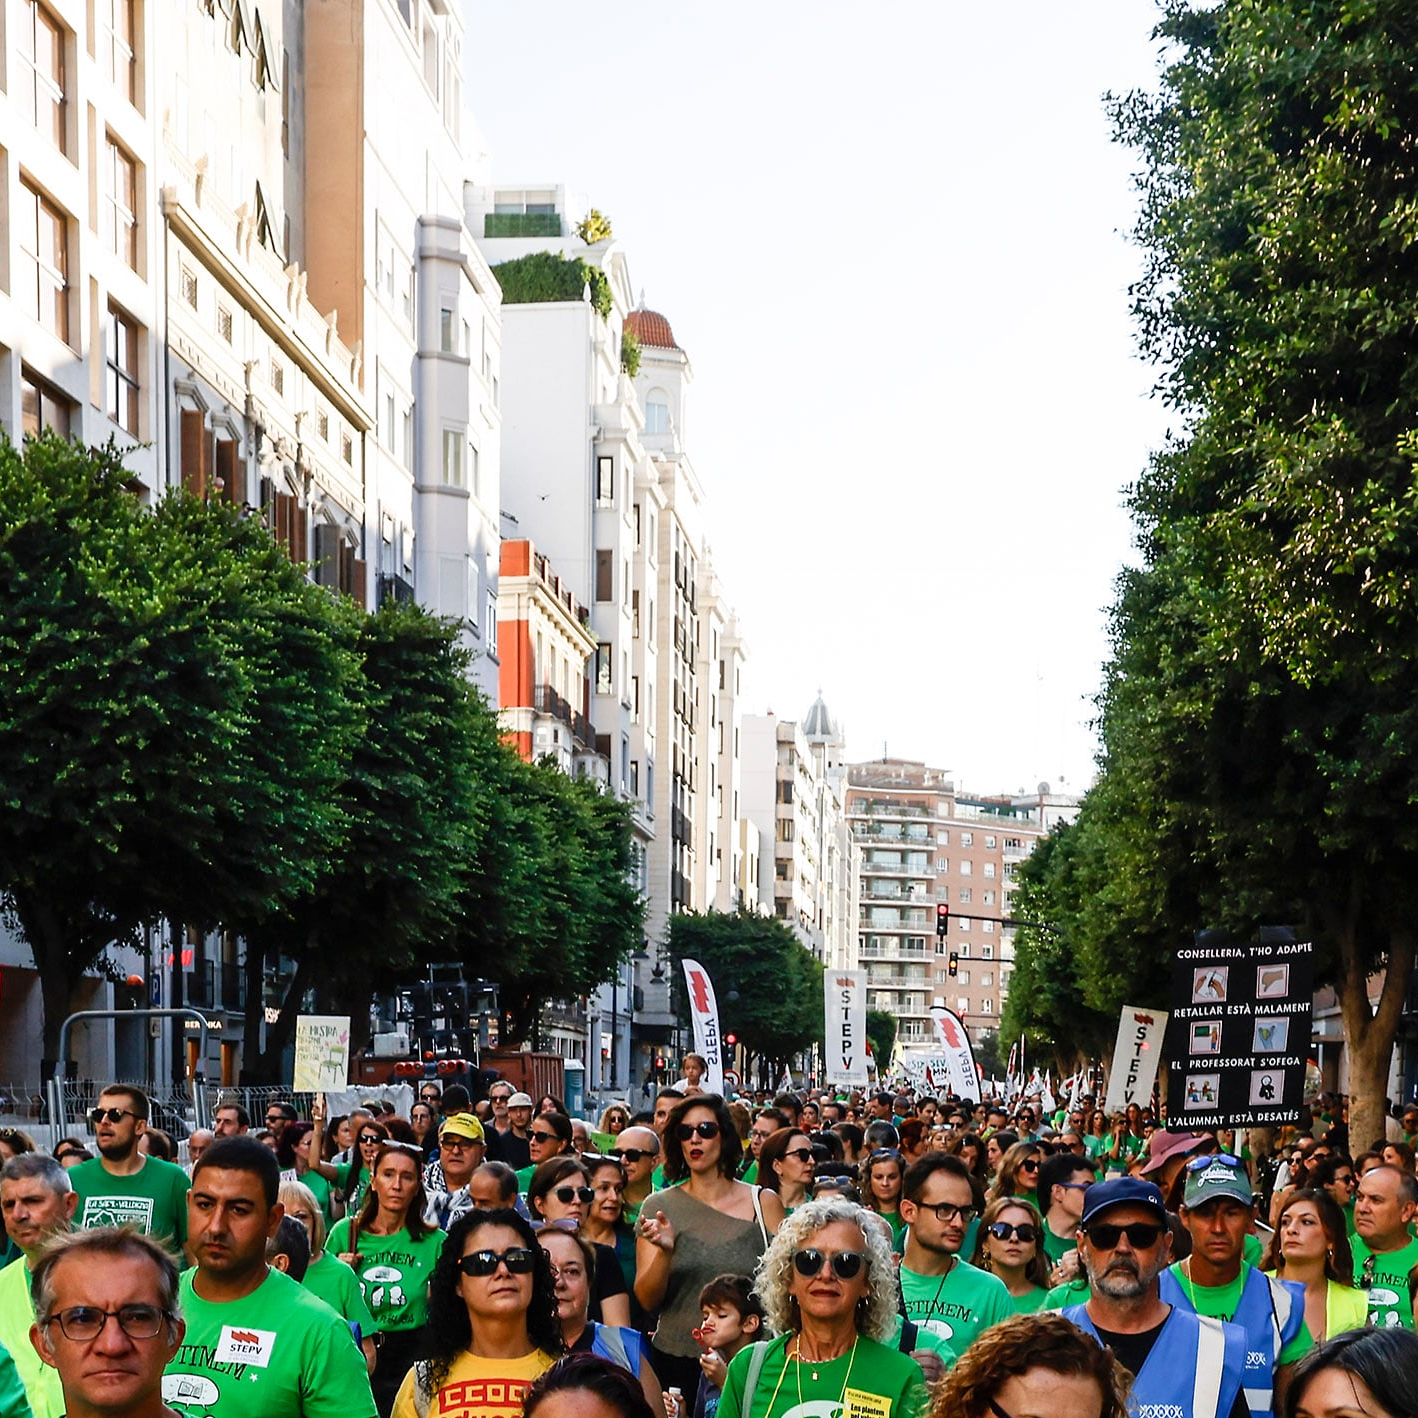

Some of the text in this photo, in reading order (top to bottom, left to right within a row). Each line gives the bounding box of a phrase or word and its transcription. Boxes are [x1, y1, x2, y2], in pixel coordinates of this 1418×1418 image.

[1177, 943, 1312, 959] CONSELLERIA, T'HO ADAPTE
[1174, 1003, 1311, 1018] RETALLAR ESTÀ MALAMENT
[184, 1020, 222, 1029] BERKA
[841, 990, 853, 1070] STEPV
[1124, 1027, 1147, 1104] STEPV
[1171, 1057, 1300, 1070] EL PROFESSORAT S'OFEGA
[1168, 1109, 1300, 1127] L'ALUMNAT ESTÀ DESATÉS
[904, 1300, 971, 1322] STIMEM
[230, 1344, 262, 1355] STEPV
